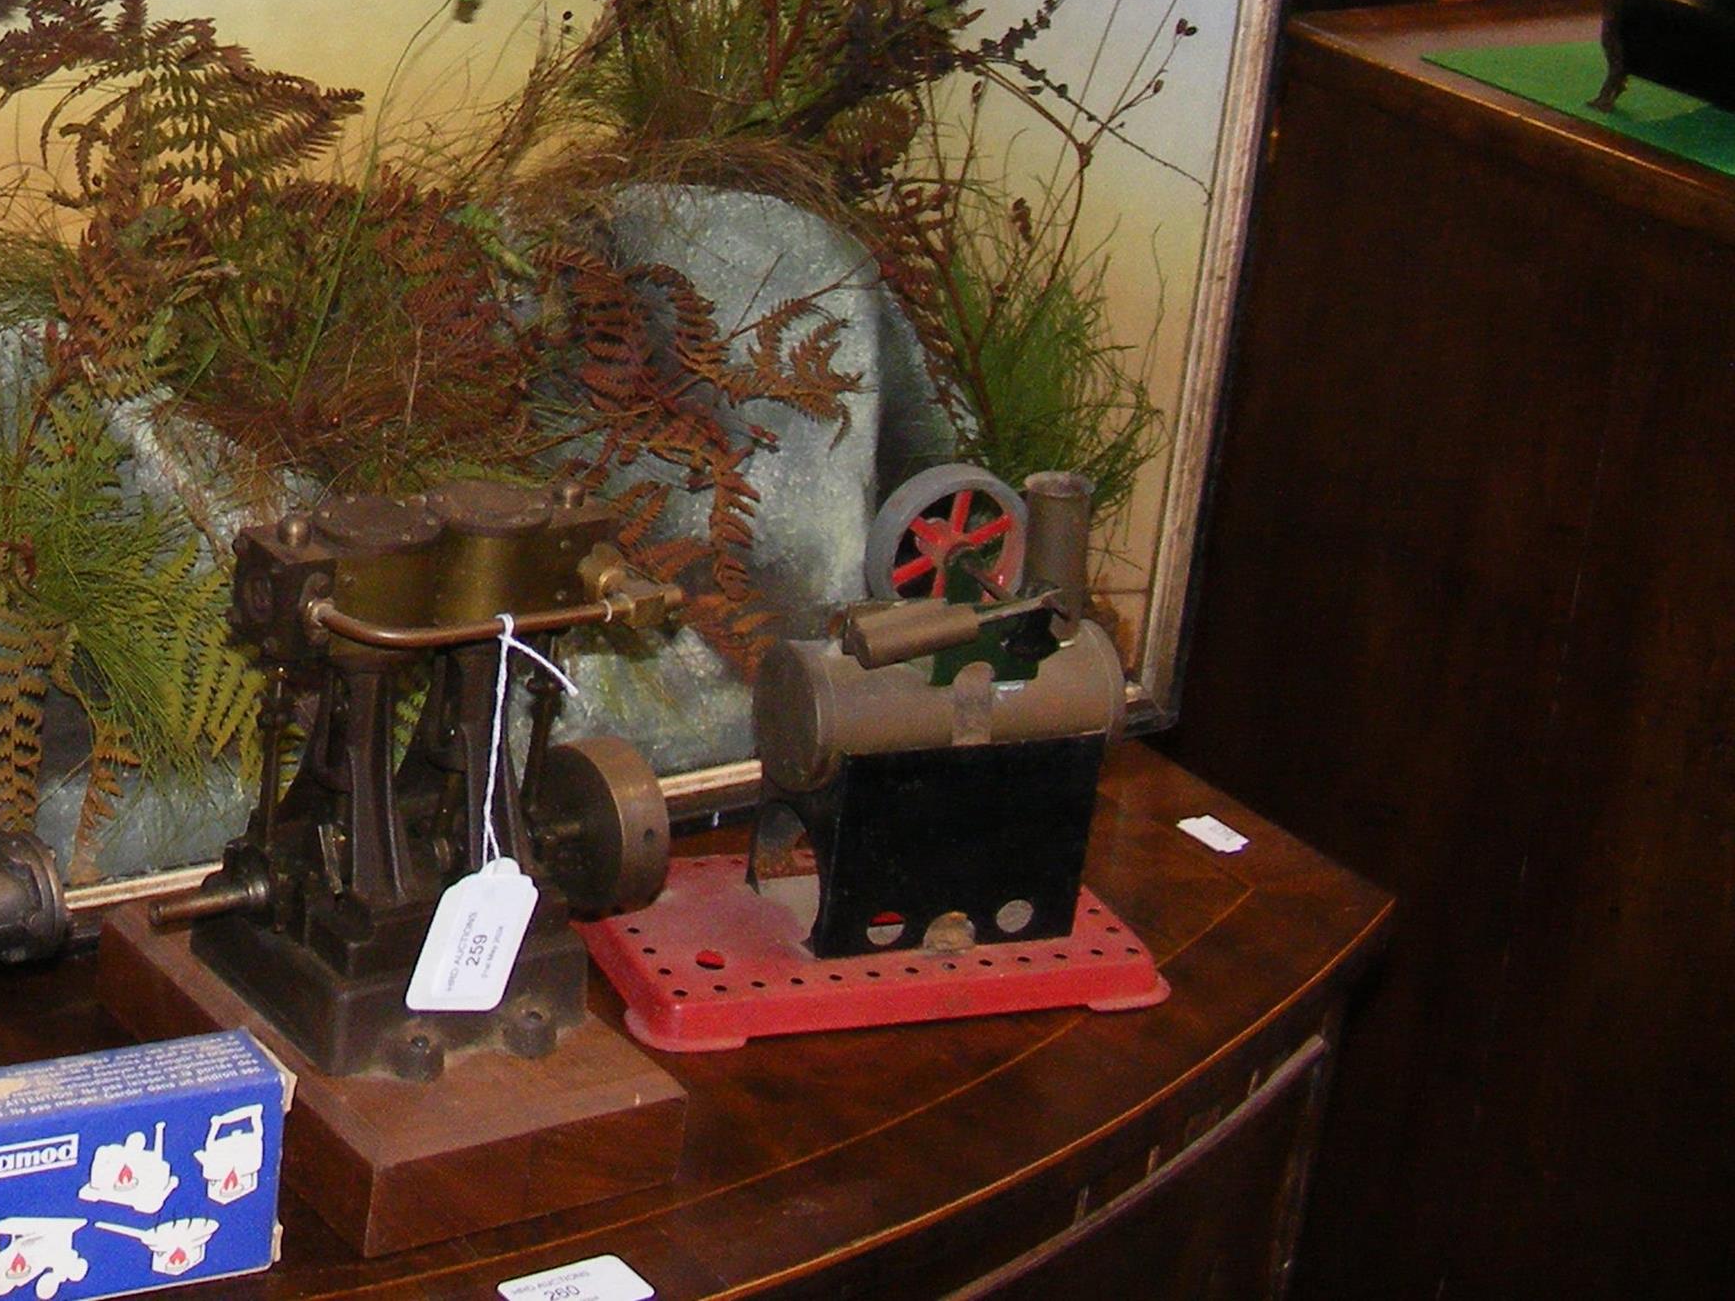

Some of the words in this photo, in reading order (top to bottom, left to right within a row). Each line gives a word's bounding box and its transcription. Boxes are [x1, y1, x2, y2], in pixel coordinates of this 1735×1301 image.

[454, 911, 477, 965] AUCTIONS
[465, 934, 488, 966] 259
[29, 1104, 52, 1115] pas
[147, 1080, 176, 1092] dans
[179, 1078, 195, 1087] un
[197, 1069, 239, 1083] endroit
[544, 1284, 580, 1301] 260
